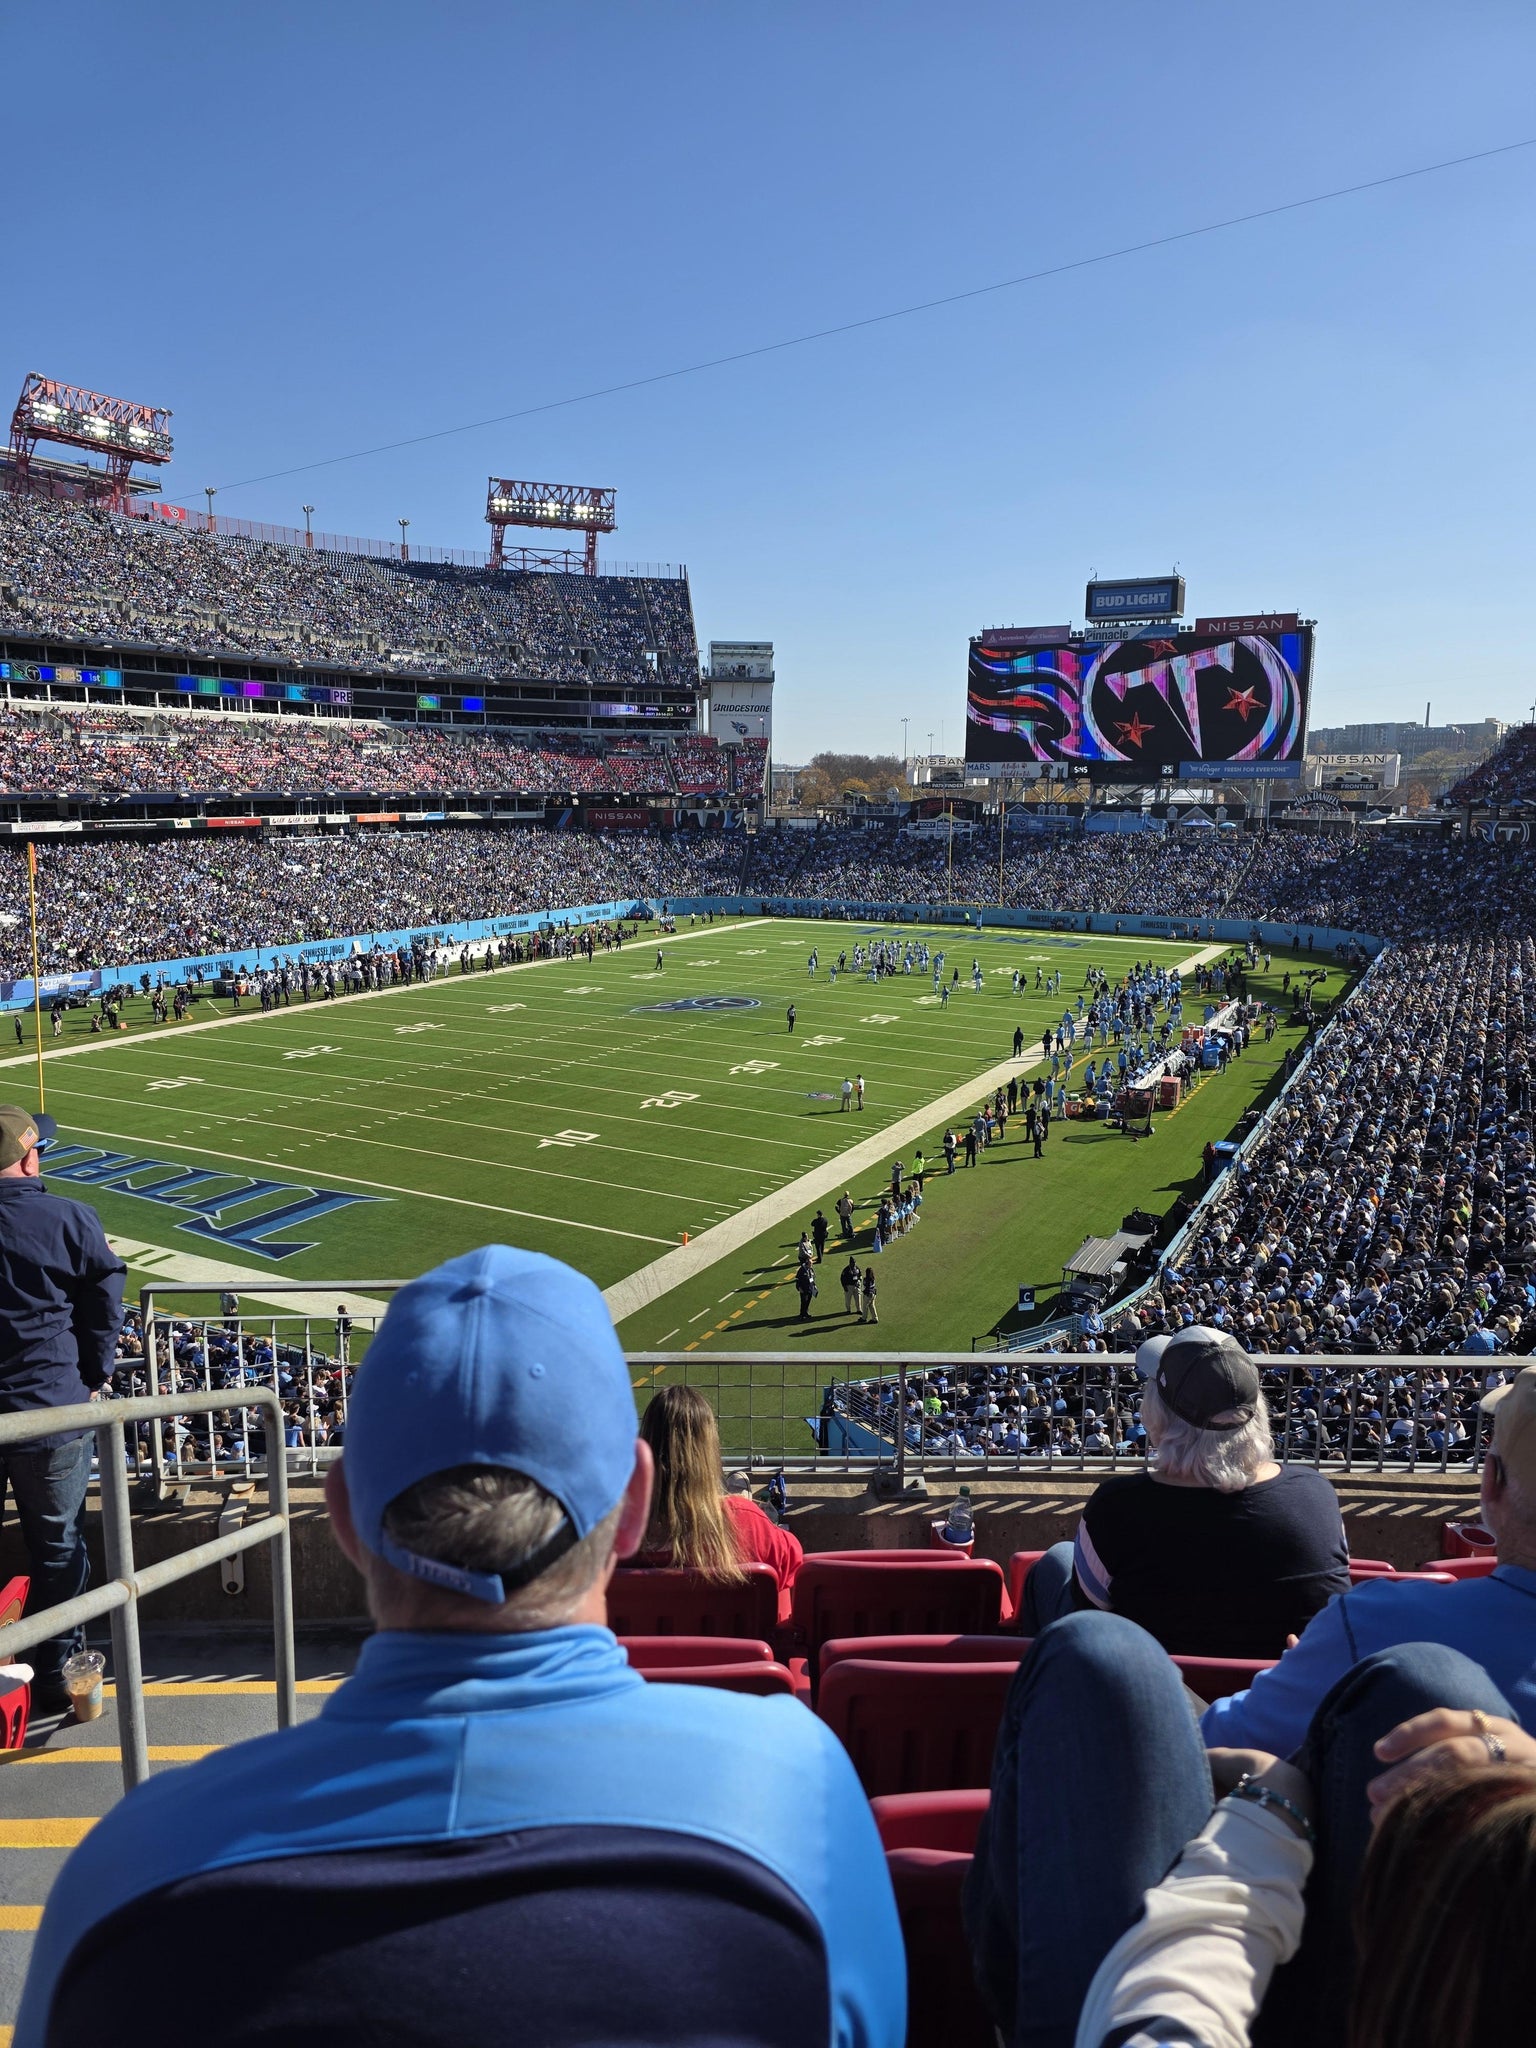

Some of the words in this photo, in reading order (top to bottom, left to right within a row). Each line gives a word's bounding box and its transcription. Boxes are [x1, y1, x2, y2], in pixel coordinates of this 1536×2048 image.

[1096, 595, 1125, 608] BUD
[1127, 592, 1168, 606] LIGHT
[1208, 619, 1284, 633] NISSAN
[1085, 629, 1129, 641] Pinnacle
[713, 703, 771, 712] BRIDGESTONE
[916, 758, 965, 766] NISSAN
[1318, 755, 1385, 764] NISSAN
[967, 763, 991, 771] MARS
[1073, 766, 1088, 774] 5:45
[1163, 765, 1172, 774] 25
[1199, 763, 1221, 776] Kroger
[1294, 793, 1312, 806] JACK
[594, 812, 642, 820] NISSAN
[1140, 920, 1169, 929] TENNESSEE
[859, 1013, 901, 1025] 50
[805, 1033, 846, 1048] 40
[288, 1045, 343, 1058] 20
[733, 1059, 782, 1075] 30
[148, 1075, 205, 1090] 10
[645, 1090, 702, 1109] 20
[539, 1129, 601, 1148] 10
[1023, 1292, 1031, 1302] C
[941, 1386, 949, 1394] 11
